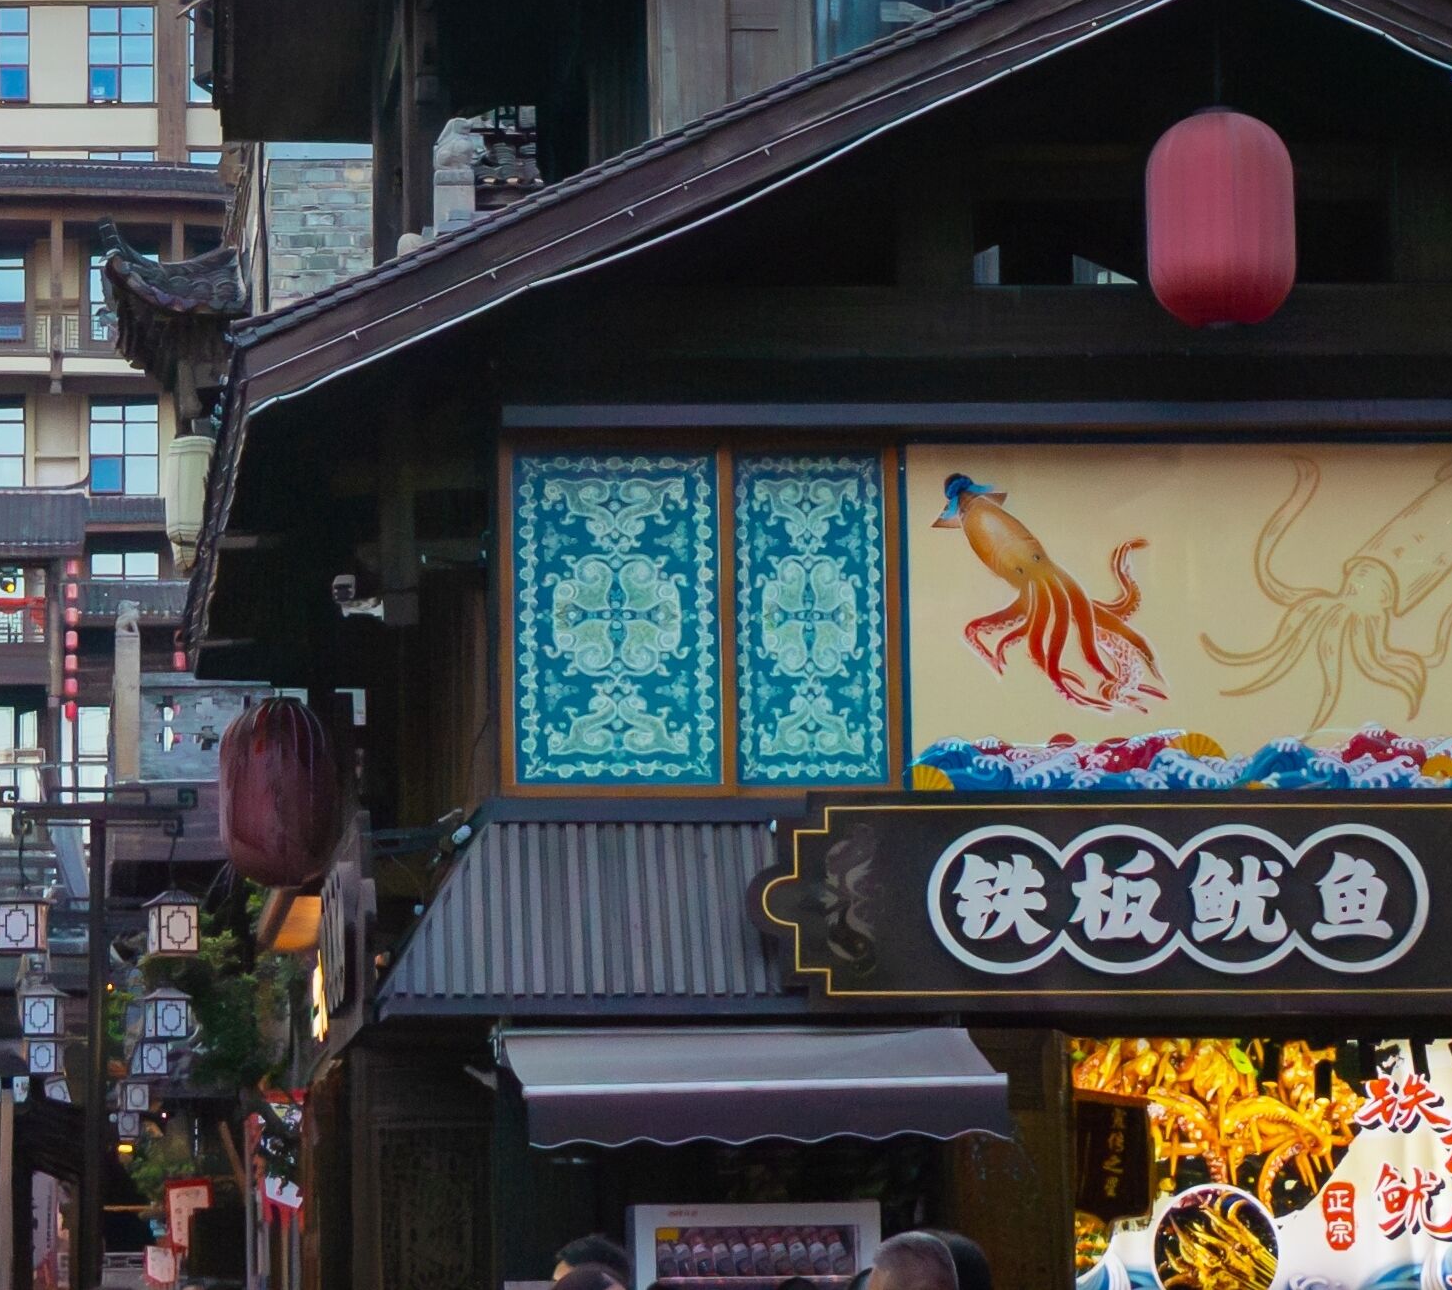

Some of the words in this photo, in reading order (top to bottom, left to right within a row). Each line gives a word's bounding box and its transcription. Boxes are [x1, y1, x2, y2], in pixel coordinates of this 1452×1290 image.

[951, 849, 1395, 945] 铁板鱿鱼
[1326, 1188, 1354, 1244] 正宗
